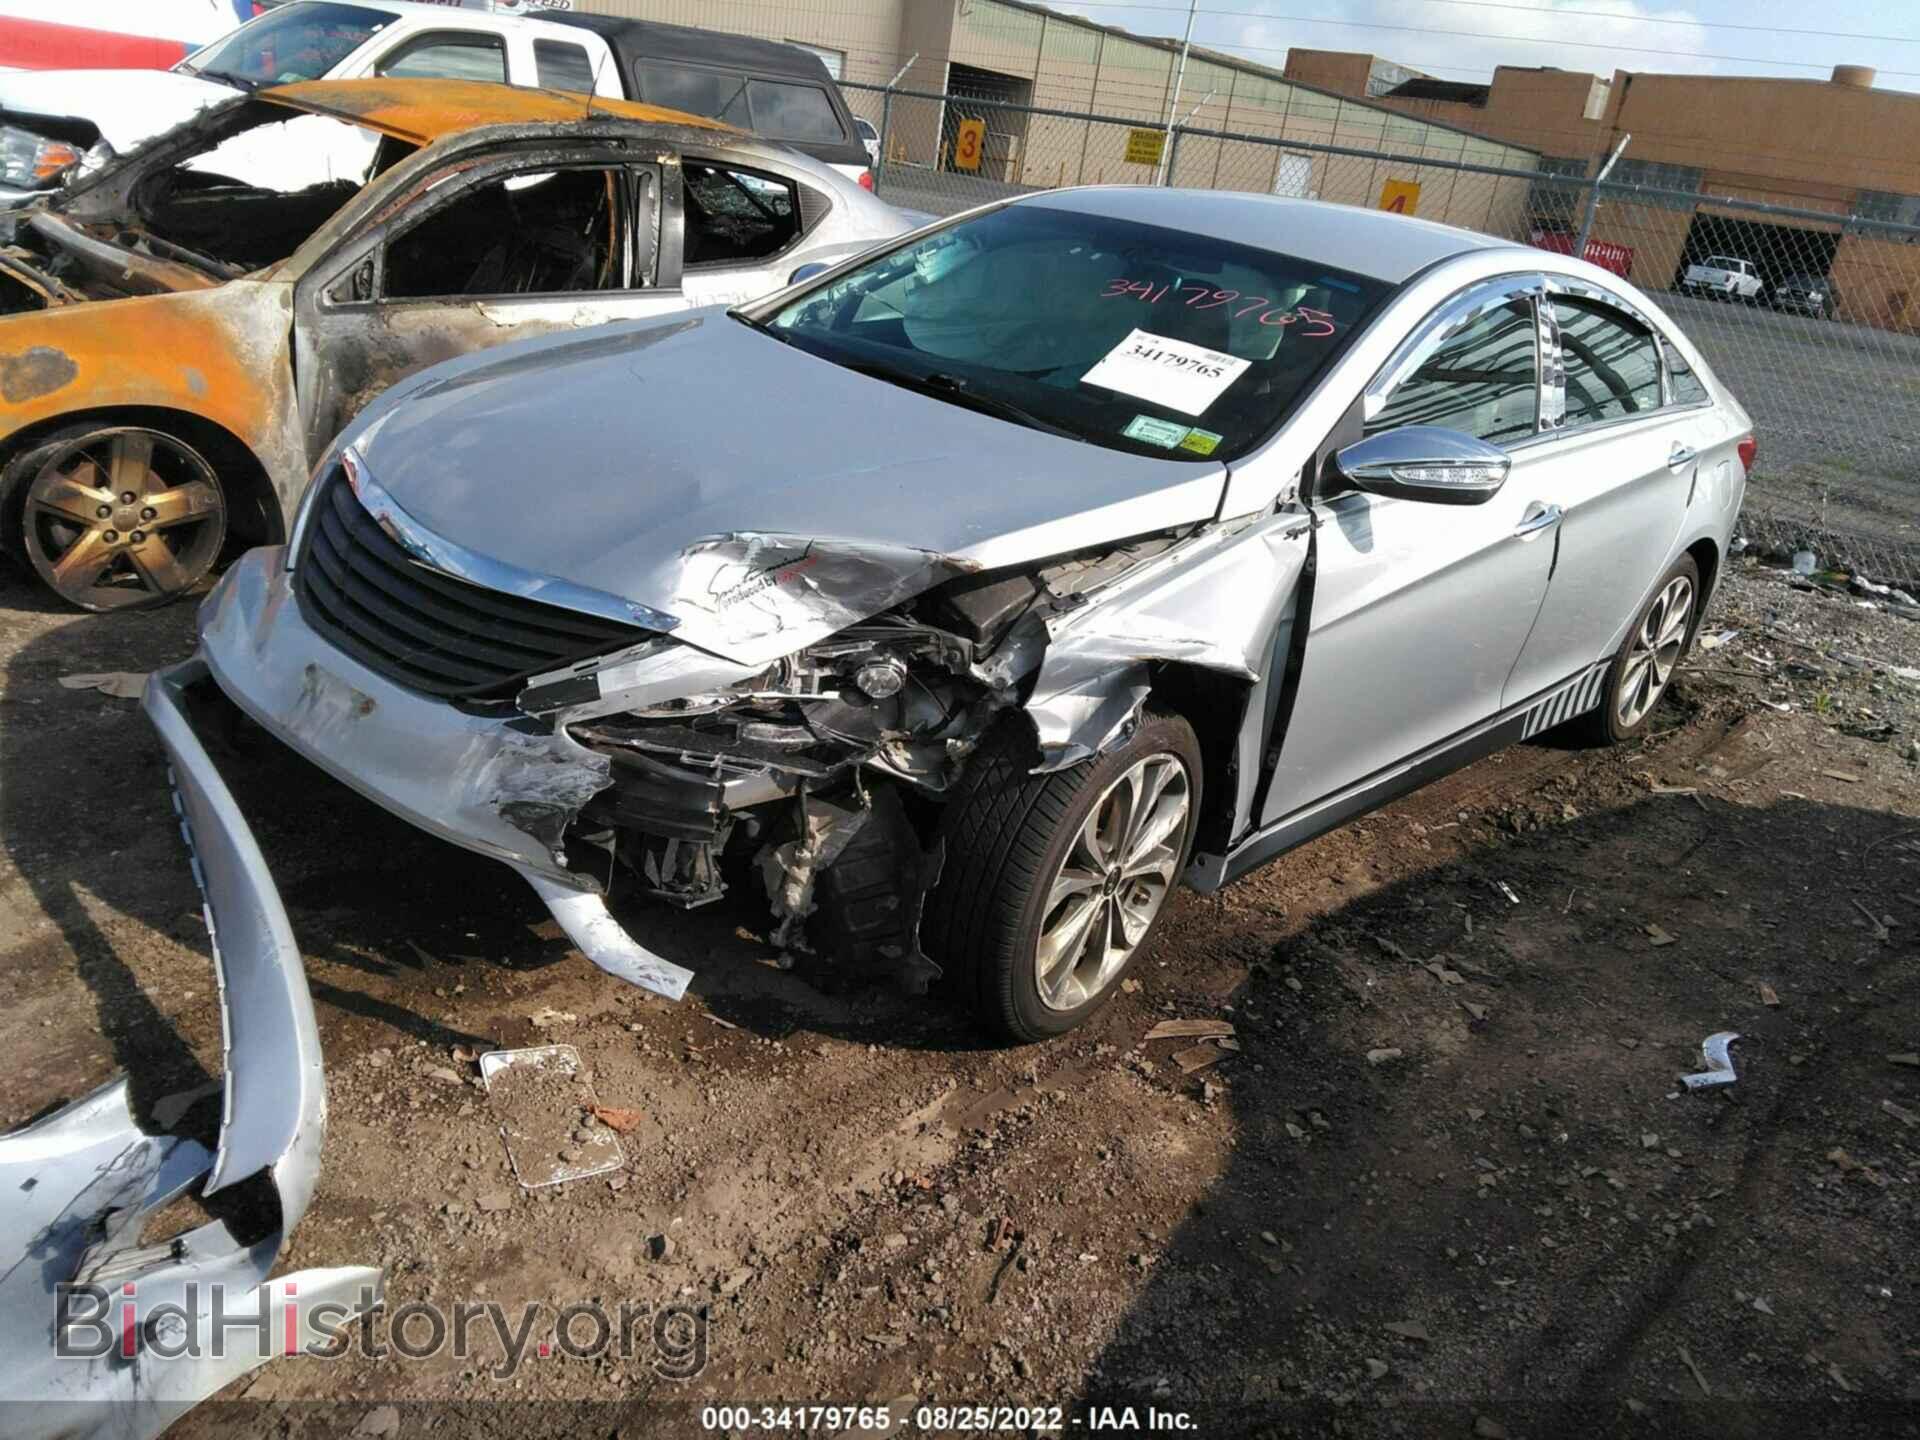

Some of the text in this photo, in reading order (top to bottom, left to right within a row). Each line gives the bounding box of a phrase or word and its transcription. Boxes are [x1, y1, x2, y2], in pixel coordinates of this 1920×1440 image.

[962, 130, 977, 159] 3
[1101, 278, 1335, 336] 34179765
[1125, 344, 1225, 378] 34179765
